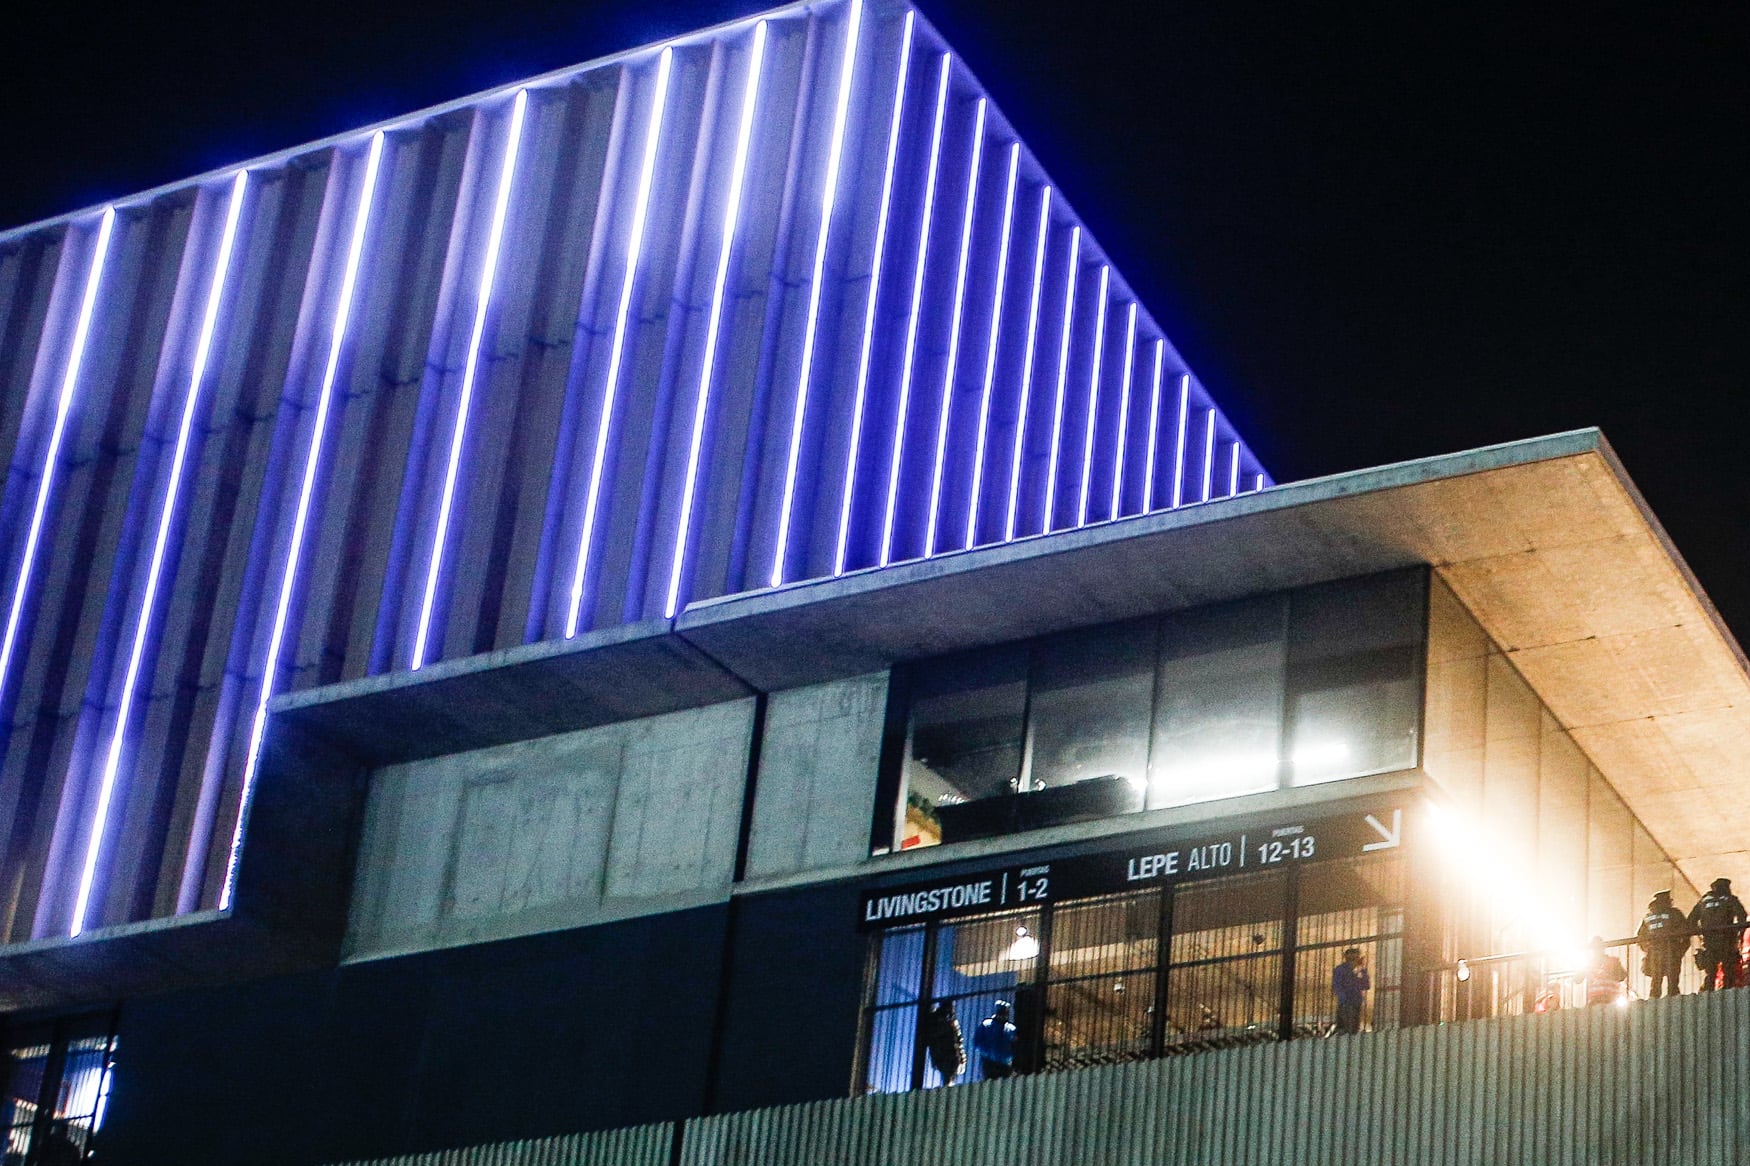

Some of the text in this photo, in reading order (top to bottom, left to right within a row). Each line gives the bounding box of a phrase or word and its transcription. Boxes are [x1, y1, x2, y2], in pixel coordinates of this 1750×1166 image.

[1127, 842, 1232, 881] LEPE ALTO
[1258, 836, 1315, 864] 12-13
[865, 880, 993, 922] LIVINGSTONE
[1017, 878, 1049, 902] 1-2
